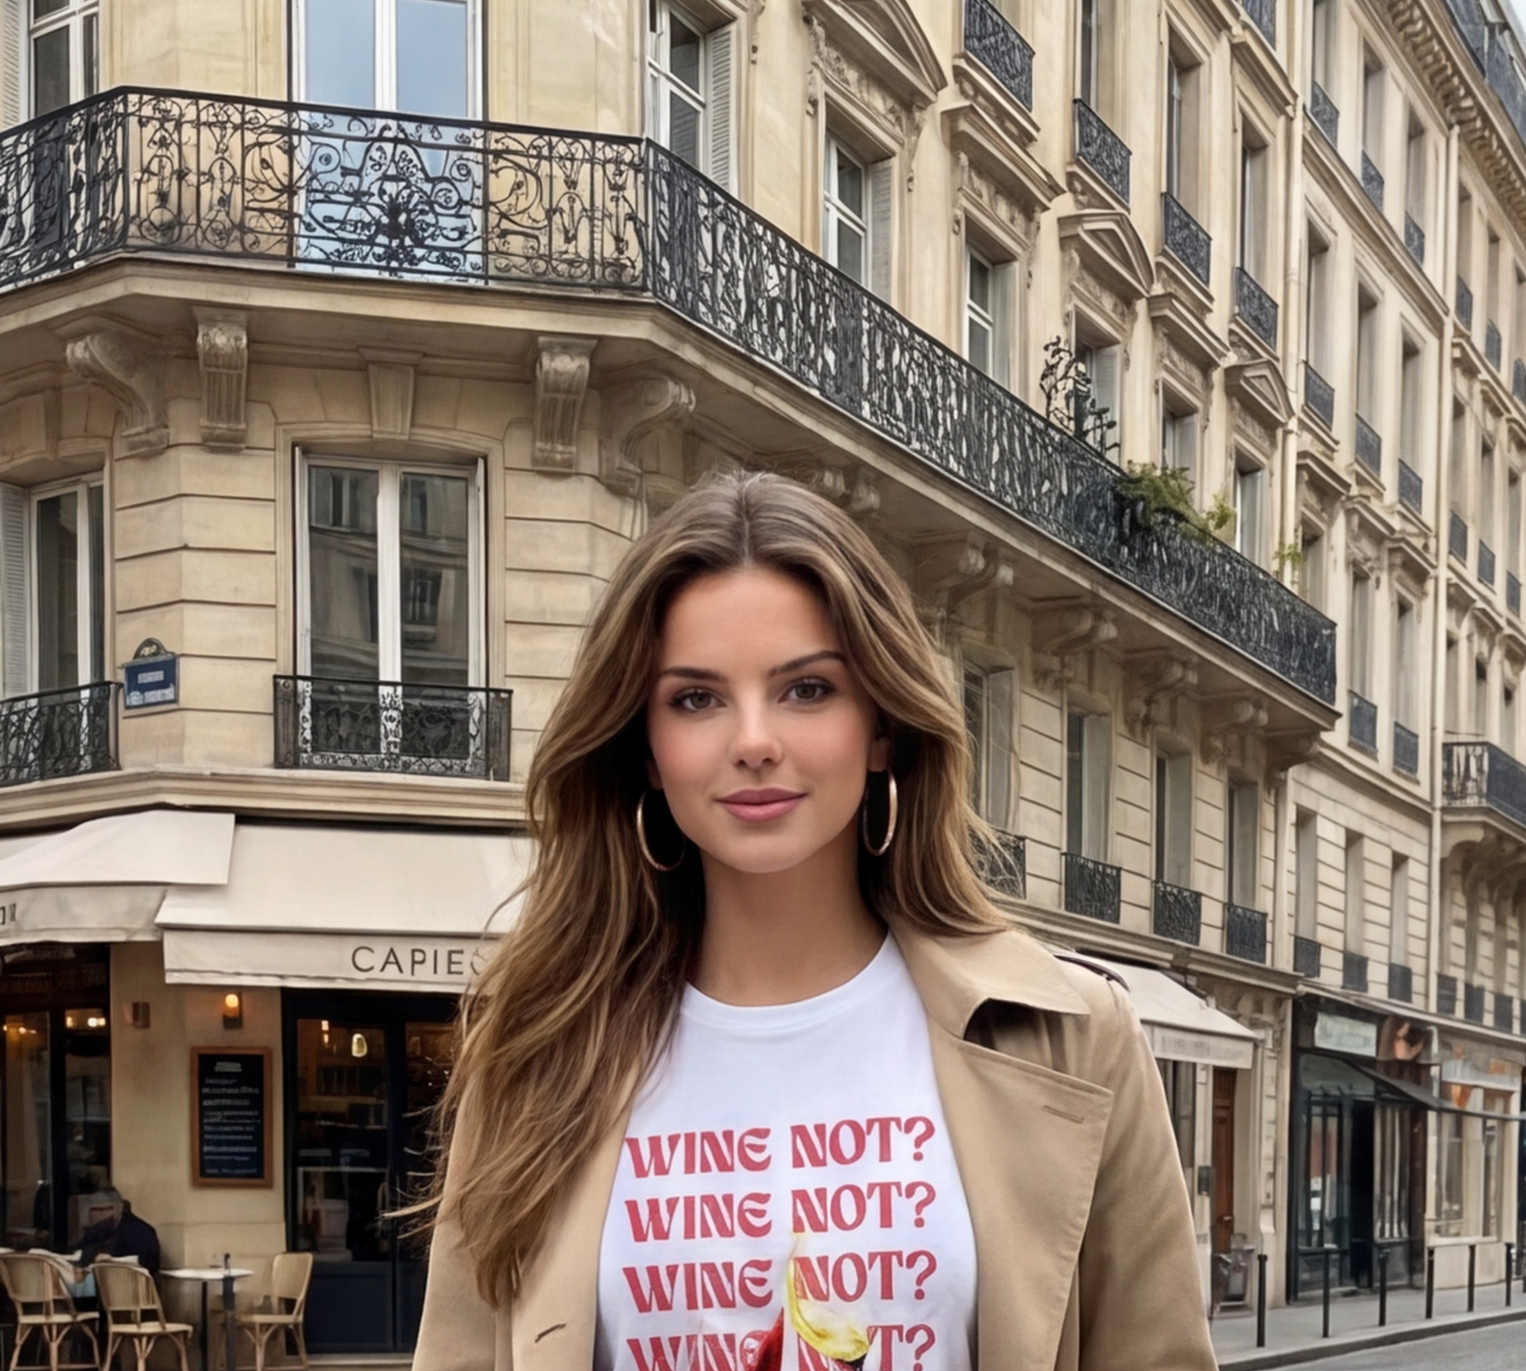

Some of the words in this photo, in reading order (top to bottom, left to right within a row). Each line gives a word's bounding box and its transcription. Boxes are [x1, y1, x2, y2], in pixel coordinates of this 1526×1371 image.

[625, 1127, 772, 1179] WINE
[791, 1116, 935, 1169] NOT?
[625, 1192, 773, 1243] WINE
[792, 1181, 936, 1235] NOT?
[622, 1259, 773, 1314] WINE
[793, 1250, 938, 1303] NOT?
